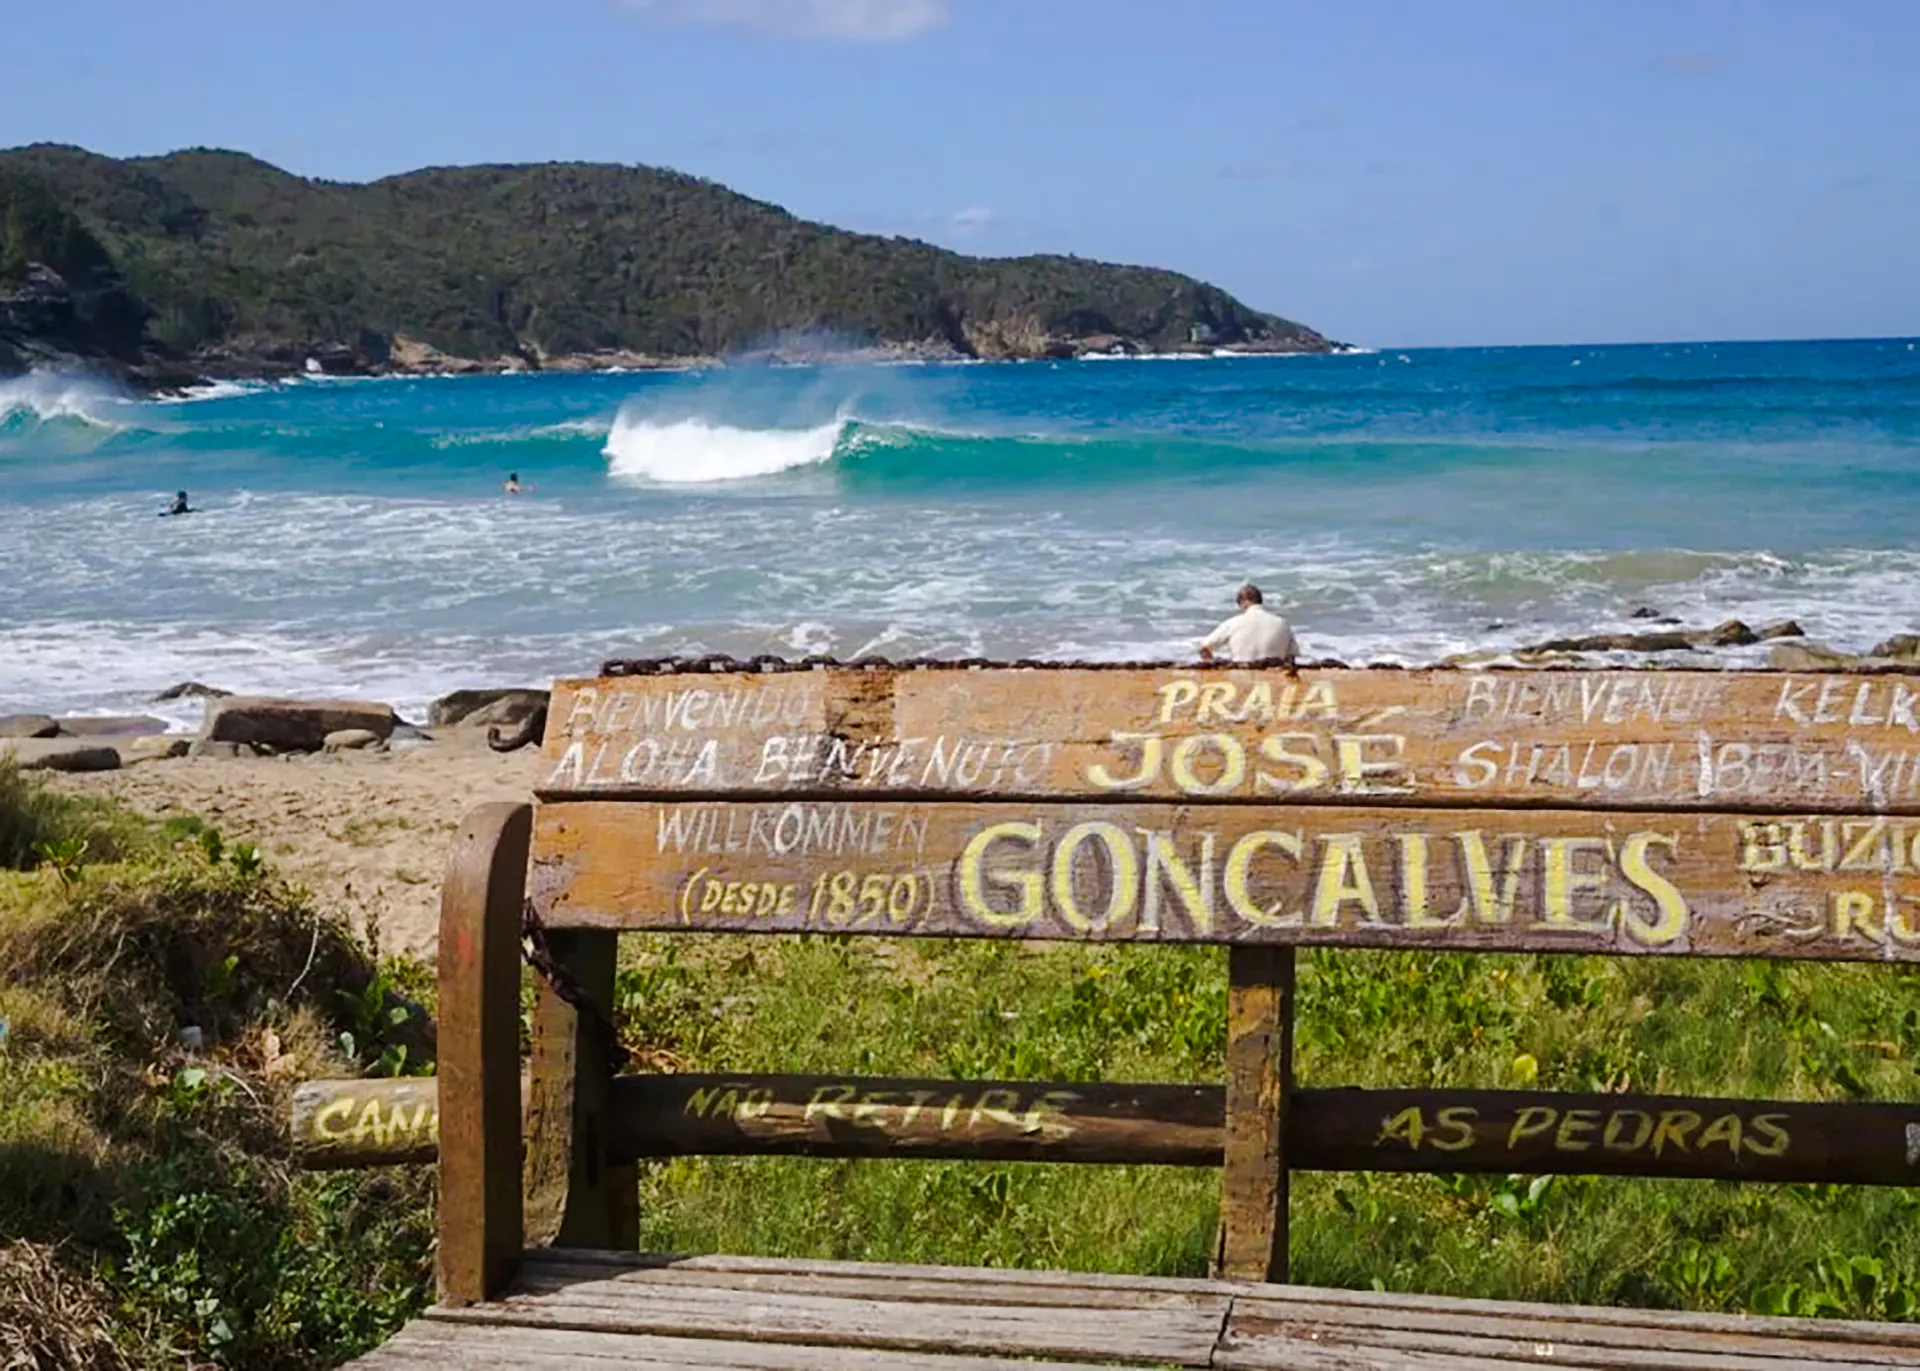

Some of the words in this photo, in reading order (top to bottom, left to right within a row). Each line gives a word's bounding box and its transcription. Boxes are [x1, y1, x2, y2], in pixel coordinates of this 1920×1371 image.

[566, 686, 812, 732] BIENVENIDO
[1158, 680, 1339, 722] PRAIA
[548, 736, 719, 787] ALOHA
[1086, 705, 1415, 794] JOSÉ
[1454, 739, 1675, 789] SHALON
[656, 804, 929, 858] WILLKOMMEN
[682, 867, 797, 925] (DESDE
[808, 871, 935, 928] 1850)
[315, 1098, 438, 1146] CAN
[804, 1084, 1085, 1141] RETIRE
[1375, 1106, 1480, 1151] AS
[1507, 1106, 1792, 1162] PEDRAS
